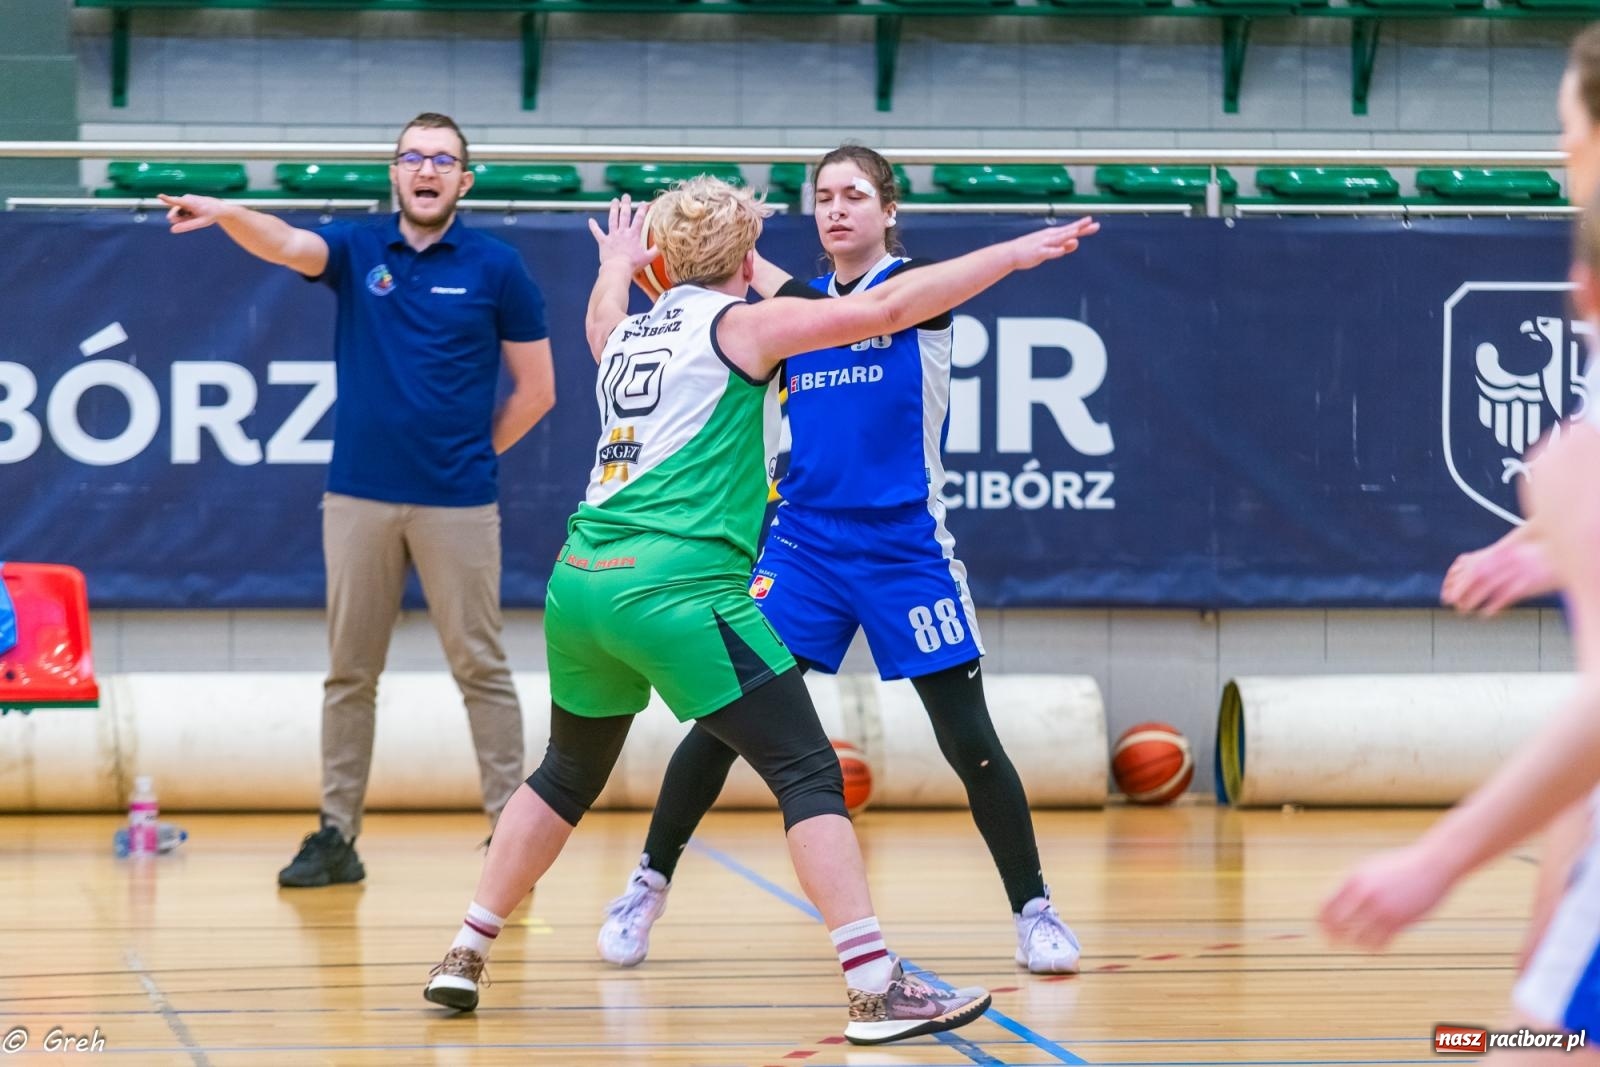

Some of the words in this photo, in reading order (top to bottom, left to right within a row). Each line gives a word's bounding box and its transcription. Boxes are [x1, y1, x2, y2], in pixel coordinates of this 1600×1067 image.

[602, 348, 673, 426] 10
[801, 364, 884, 391] BETARD
[908, 597, 965, 654] 88
